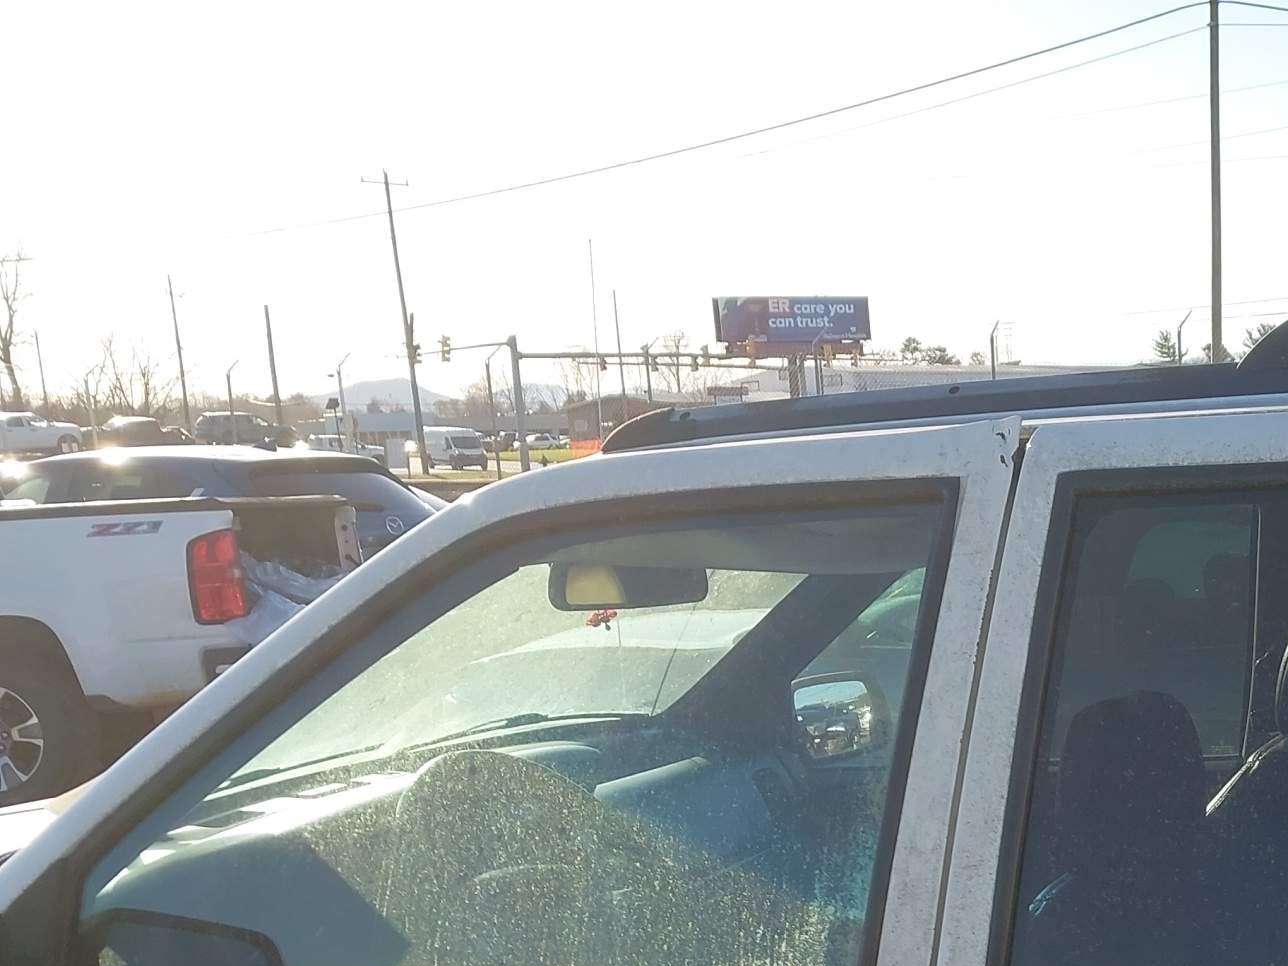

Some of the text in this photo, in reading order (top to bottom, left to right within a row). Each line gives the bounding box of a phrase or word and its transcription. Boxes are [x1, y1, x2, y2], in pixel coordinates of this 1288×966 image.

[768, 298, 854, 317] ER care you
[768, 316, 833, 328] can trust.
